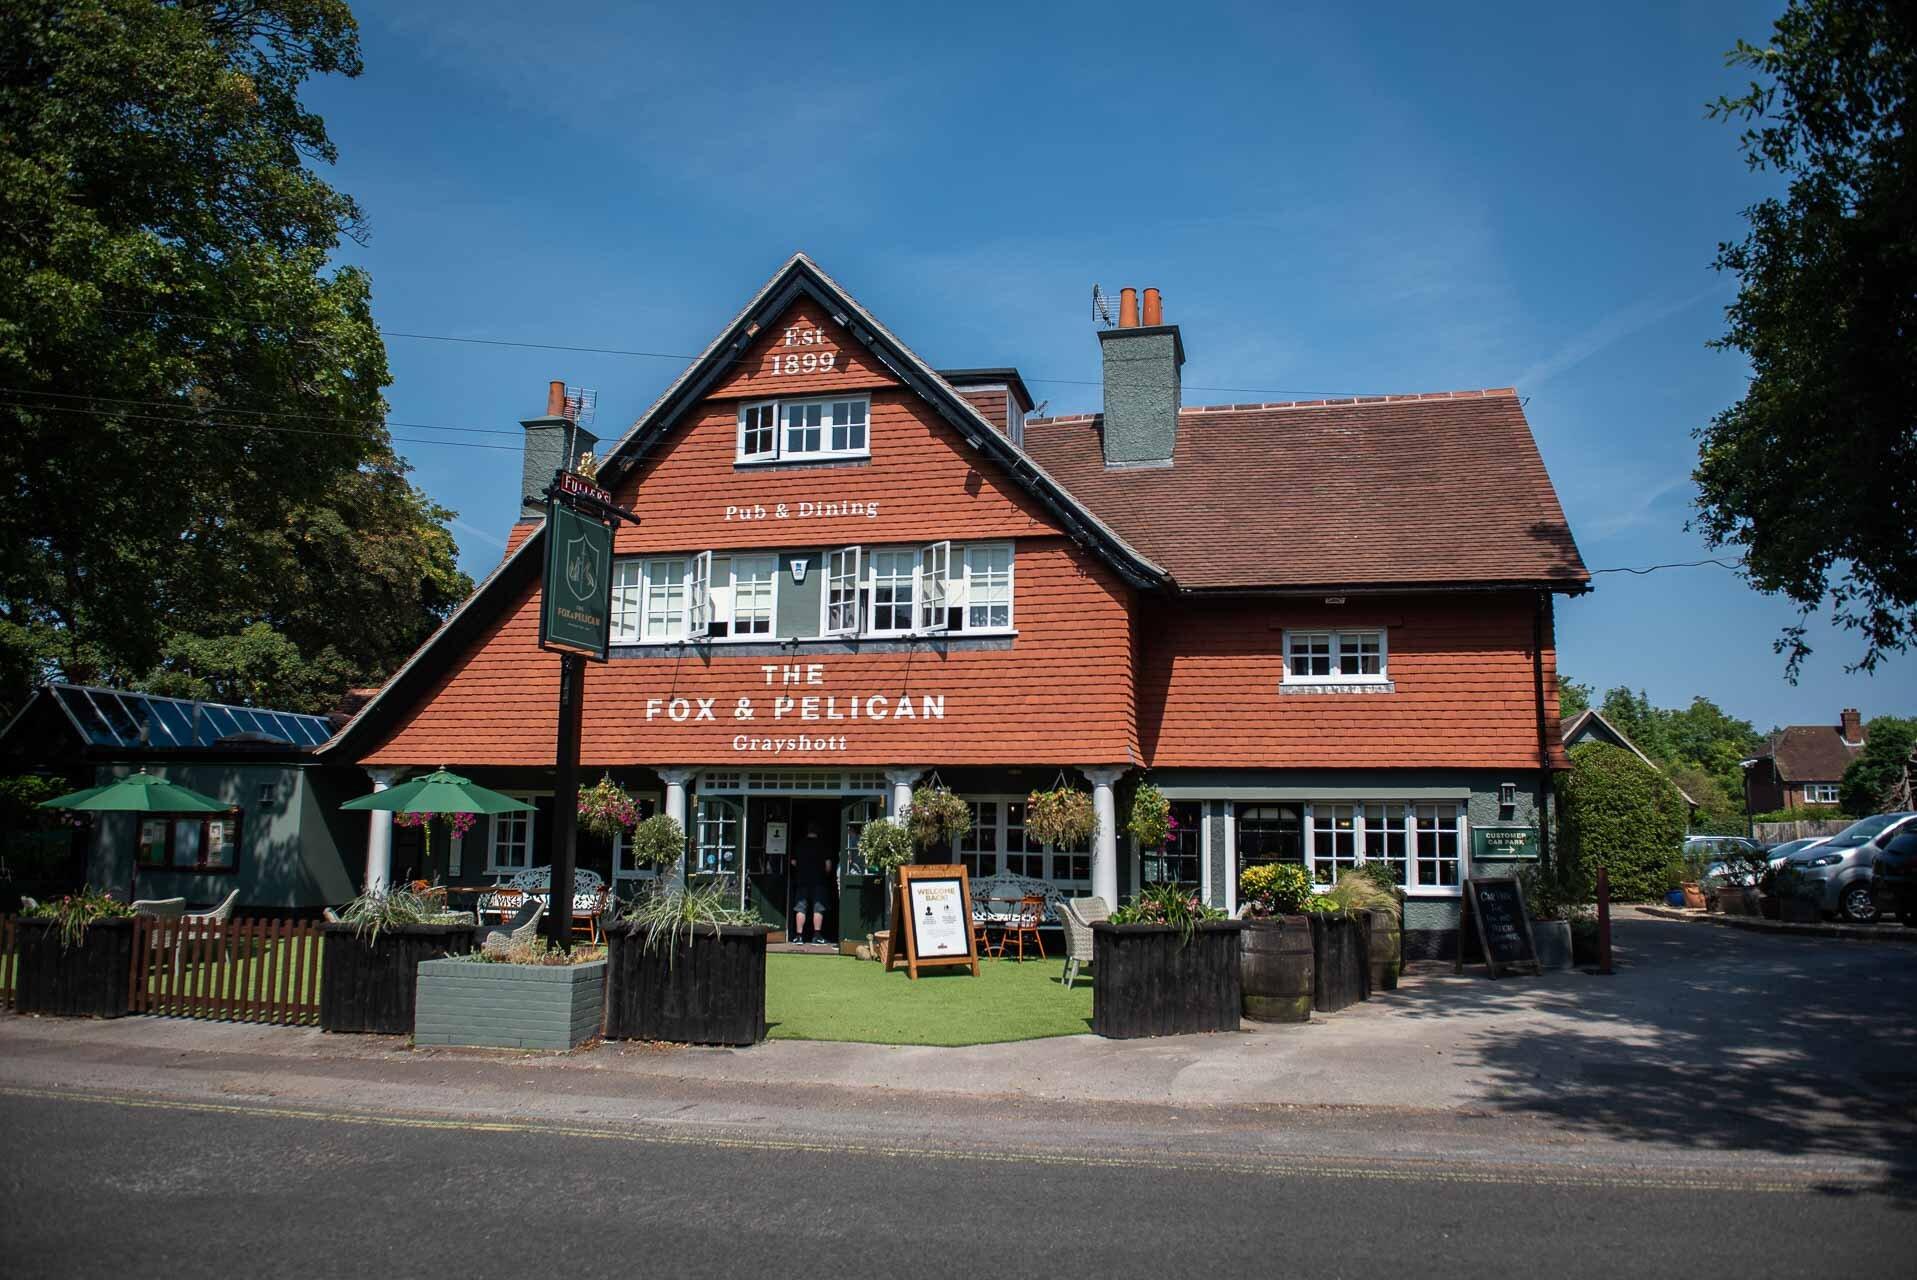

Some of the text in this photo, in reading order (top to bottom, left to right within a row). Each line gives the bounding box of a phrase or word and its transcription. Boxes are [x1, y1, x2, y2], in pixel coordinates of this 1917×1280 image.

[784, 327, 824, 347] Est
[771, 352, 836, 376] 1899
[724, 500, 880, 520] Pub & Dining
[761, 663, 824, 685] THE
[645, 694, 946, 722] FOX & PELICAN
[732, 734, 847, 754] Grayshott
[917, 887, 955, 895] WELCOME
